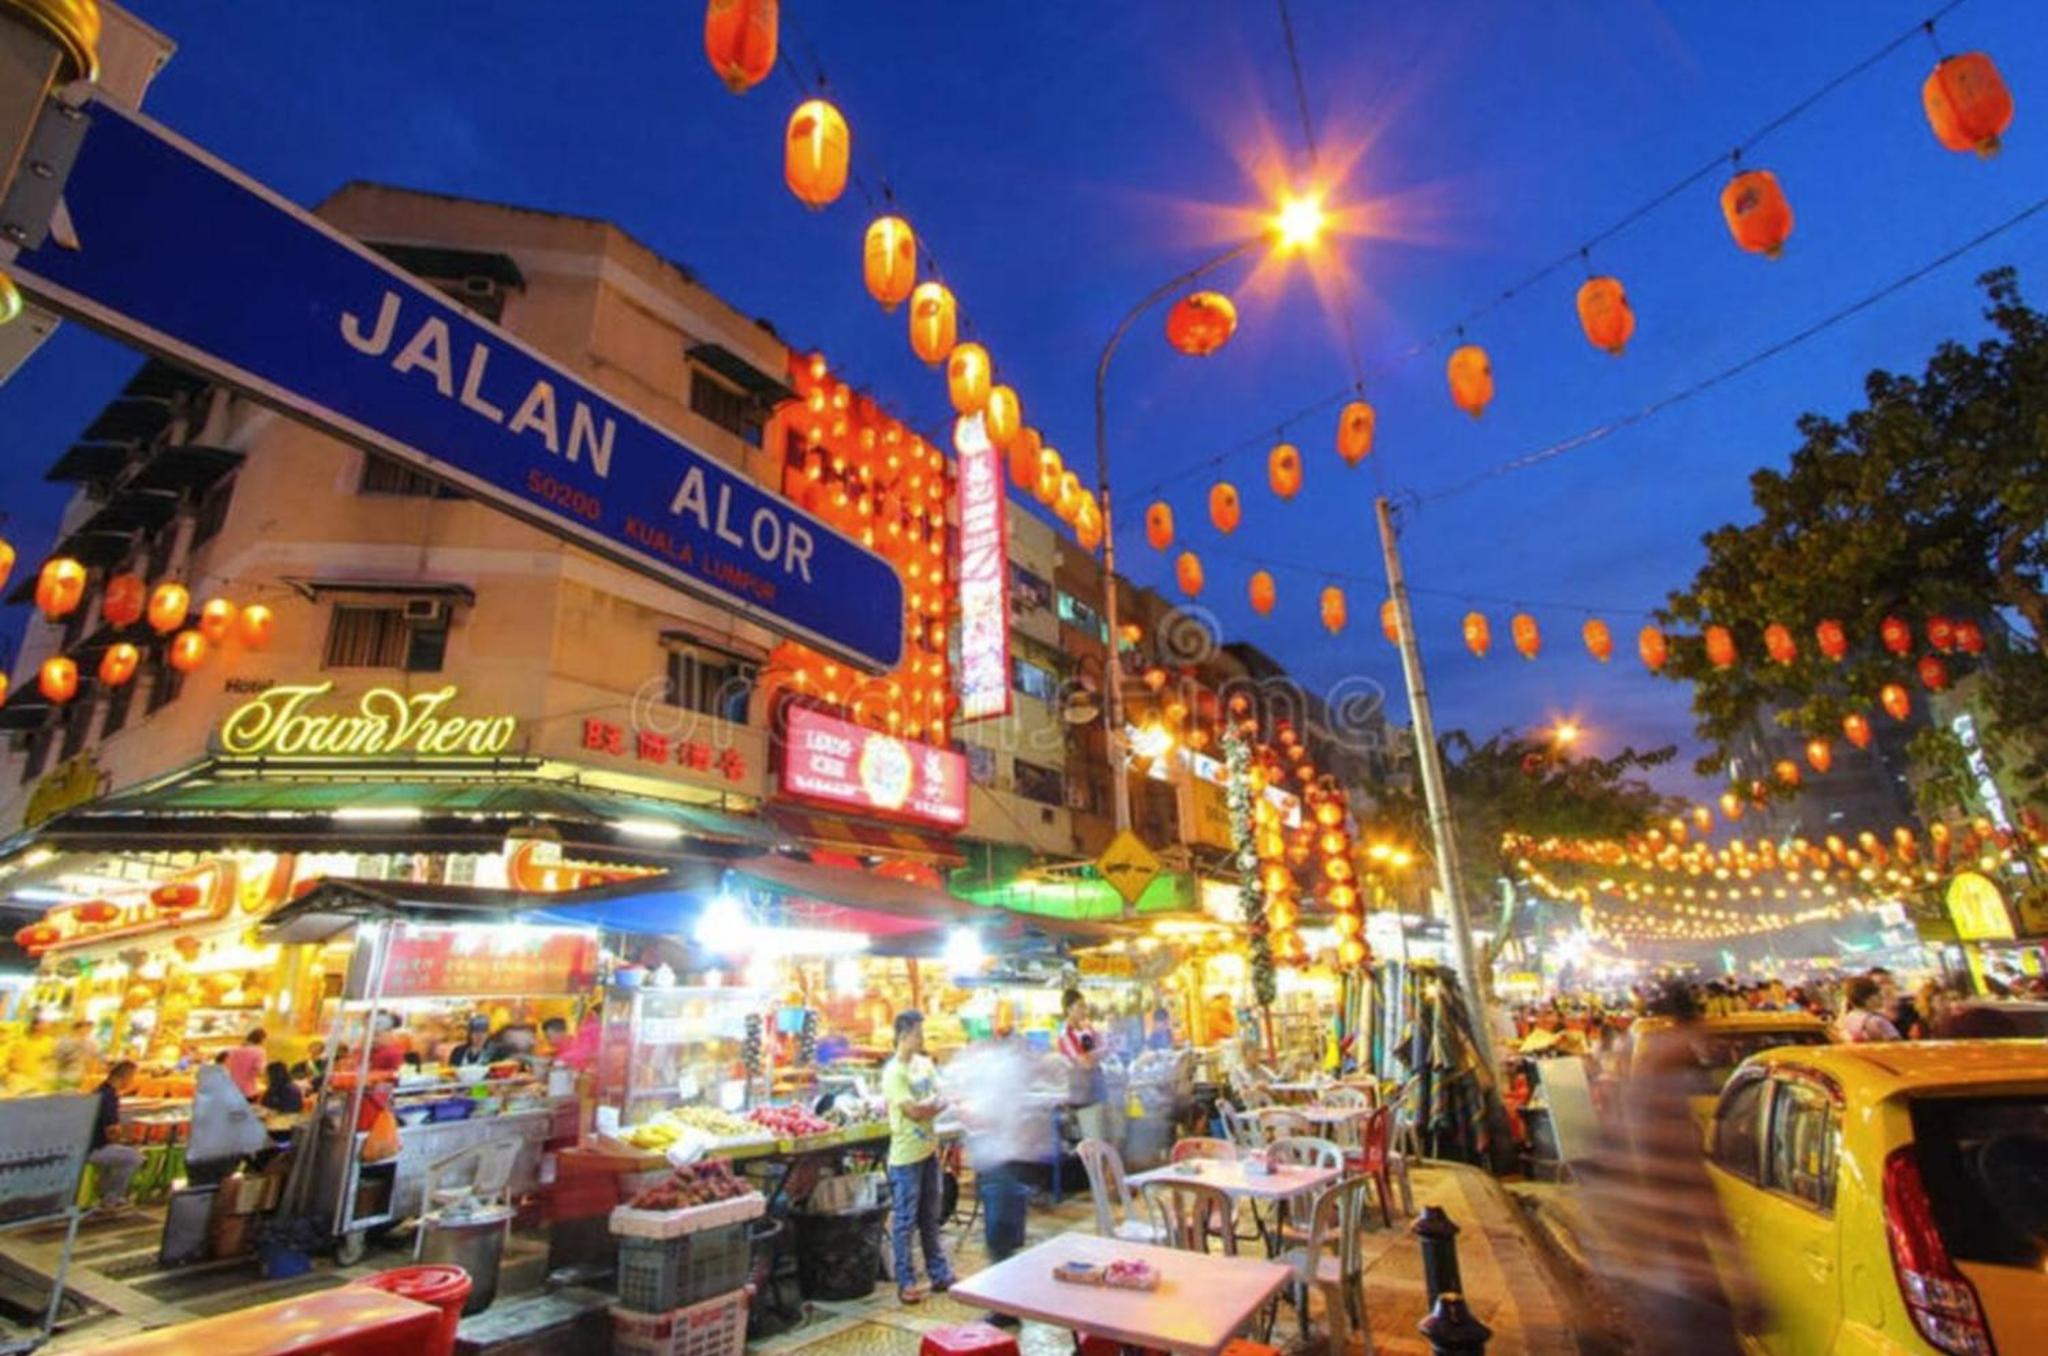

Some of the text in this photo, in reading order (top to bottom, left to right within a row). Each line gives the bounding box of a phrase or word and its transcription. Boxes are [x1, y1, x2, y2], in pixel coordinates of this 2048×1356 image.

[340, 290, 616, 478] JALAN
[669, 465, 815, 583] ALOR
[528, 469, 777, 600] 50200 KUALA LUMPUR
[225, 679, 274, 693] Hotel
